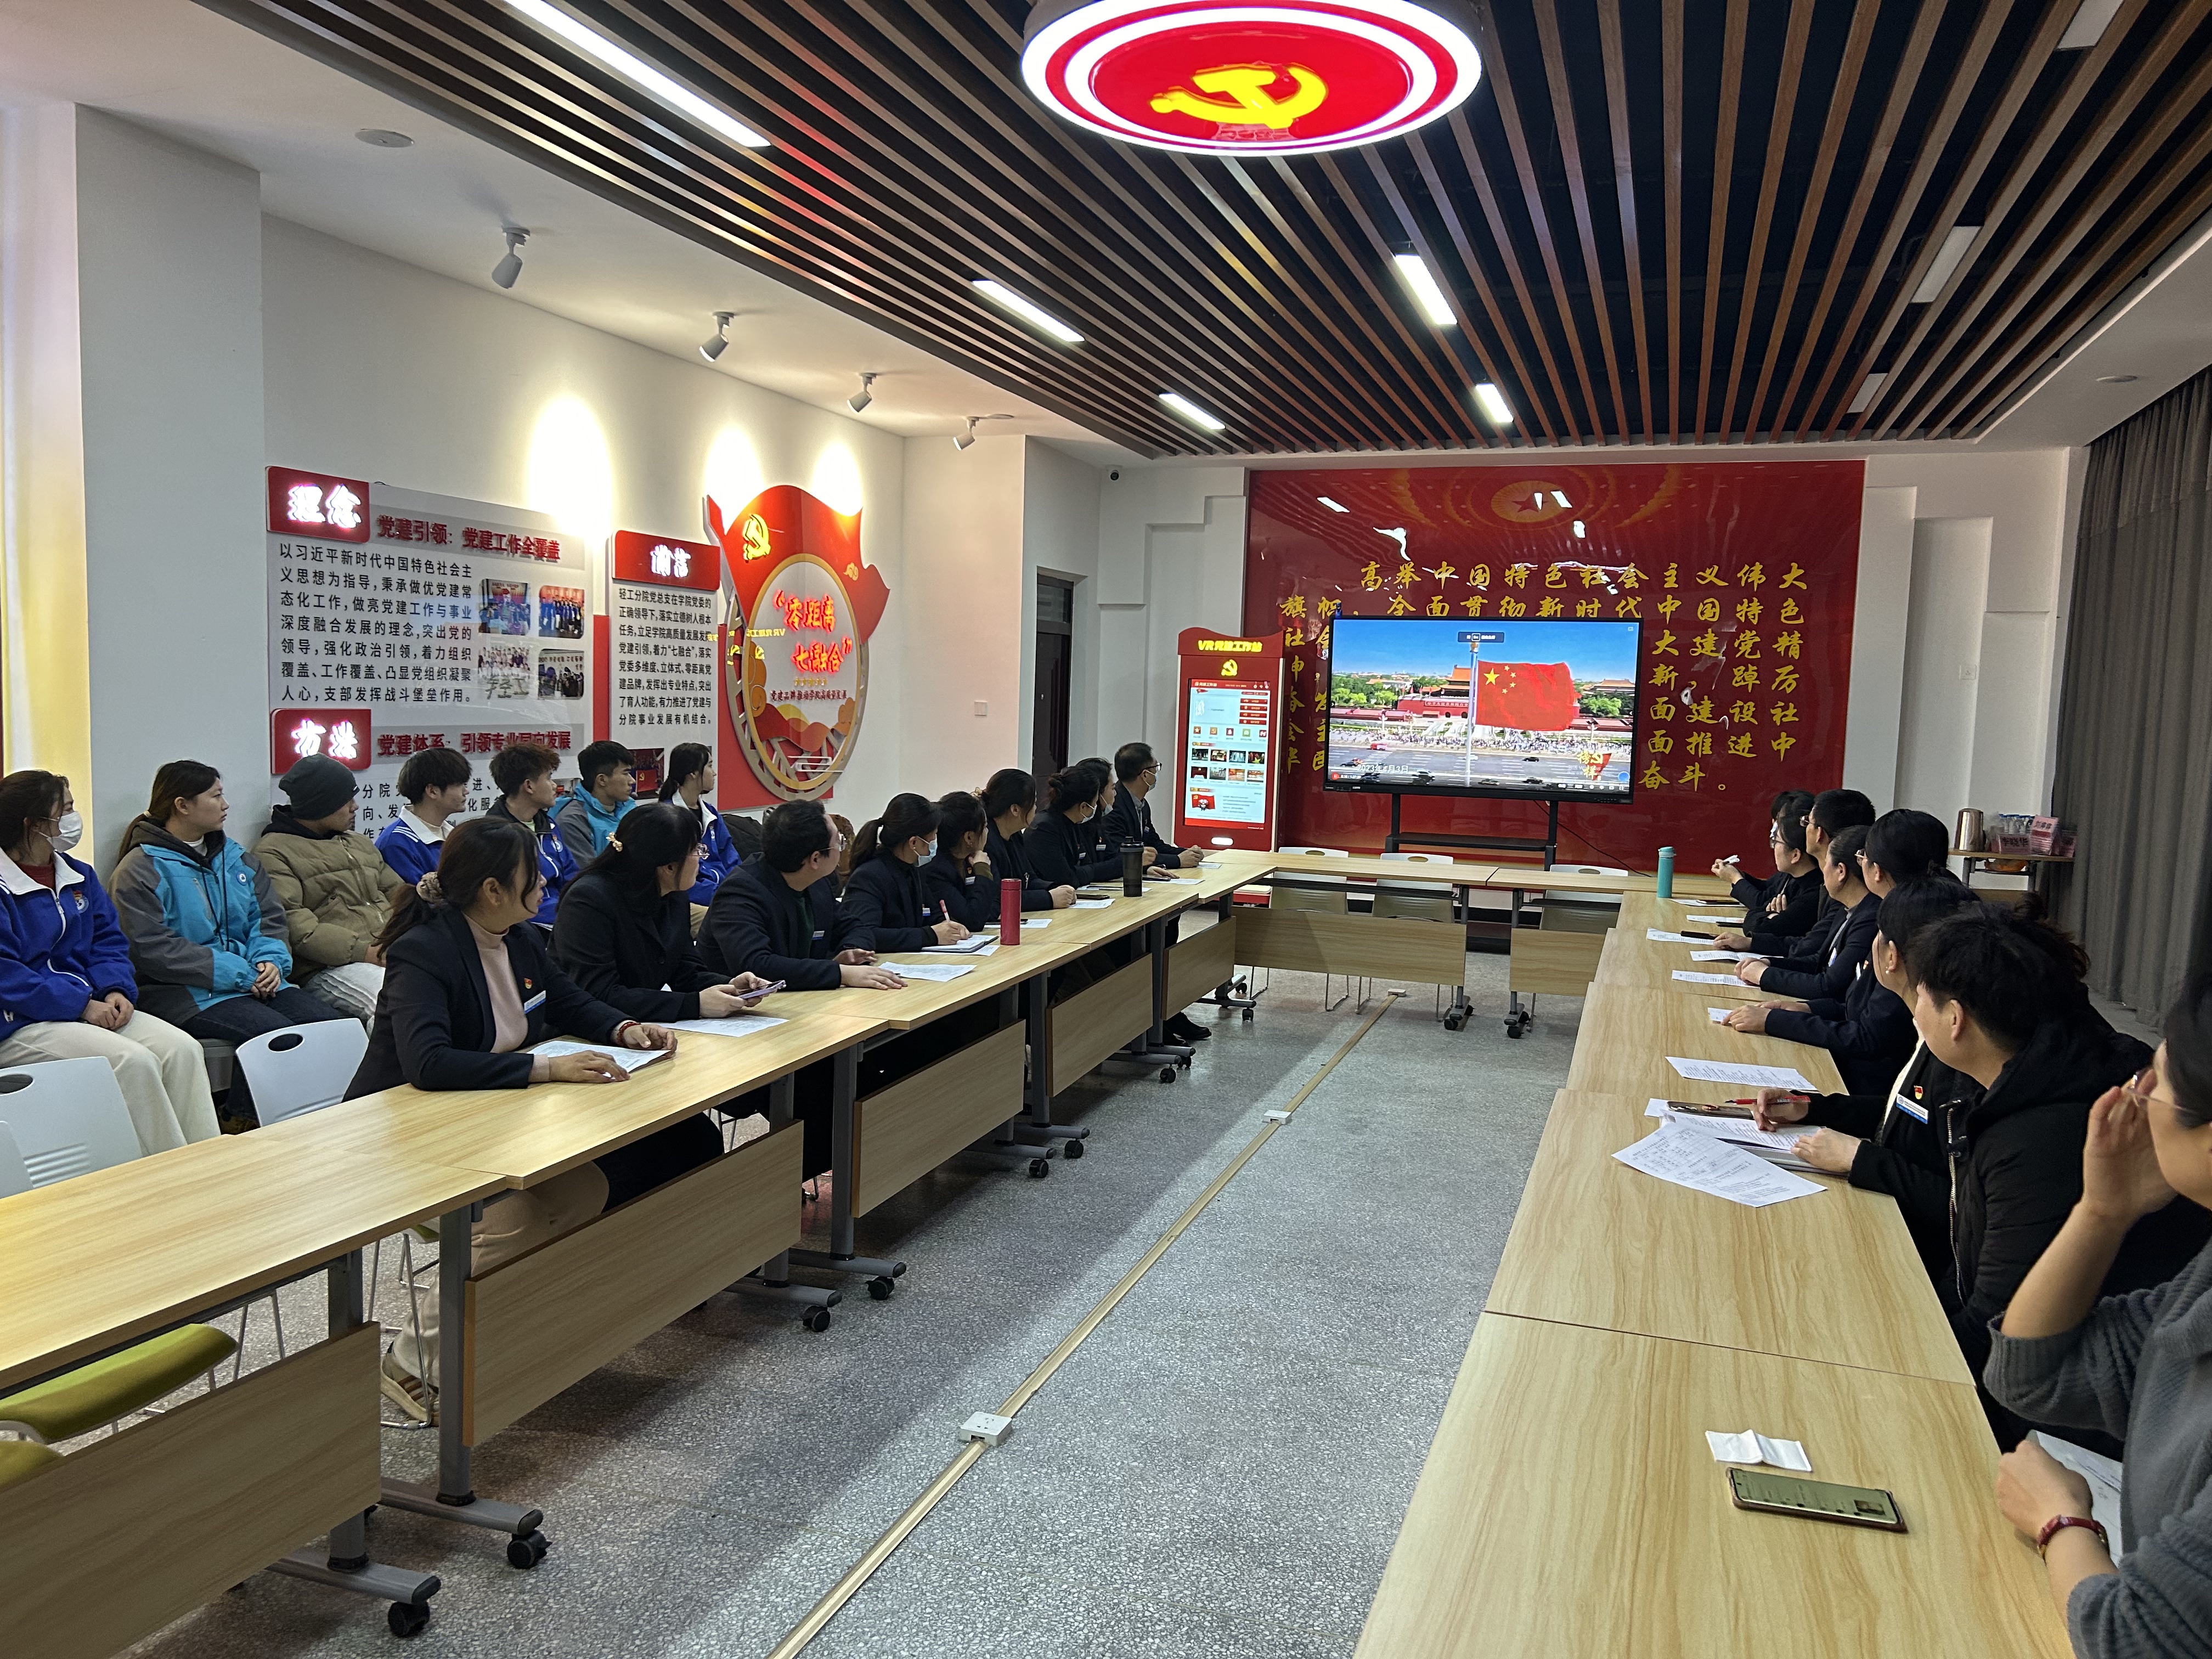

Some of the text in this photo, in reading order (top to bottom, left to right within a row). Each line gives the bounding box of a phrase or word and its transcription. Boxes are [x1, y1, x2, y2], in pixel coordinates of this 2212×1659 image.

[280, 543, 472, 579] 以习近平新时代中国特色社会主
[280, 567, 472, 599] 义思想为指导，秉承做优党建常
[1361, 561, 1807, 591] 高举中国特色社会主义伟大
[280, 590, 472, 619] 态化工作，做亮党建工作与事业
[618, 588, 712, 609] 轻工分院党总支在学院党委的
[618, 606, 712, 625] 正确领导下，落实立德树人根本
[281, 614, 472, 641] 深度融合发展的理念，突出党的
[281, 638, 472, 662] 领导，强化政治引领，着力组织
[1652, 629, 1804, 659] 大建党精
[281, 662, 472, 681] 覆盖、工作覆盖、凸显党组织凝聚
[618, 660, 712, 675] 党委多维度、立体式、零距离党
[281, 685, 470, 702] 人心，支部发挥战斗堡垒作用。
[618, 678, 712, 691] 建品牌，发挥出专业特点，突出
[618, 696, 712, 708] 了育人功能，有力推进了党建与
[1650, 695, 1799, 725] 面建设社
[618, 714, 711, 725] 分院事业发展有机结合。
[1647, 731, 1797, 761] 面推进中
[1357, 765, 1409, 774] 2023年4月3日
